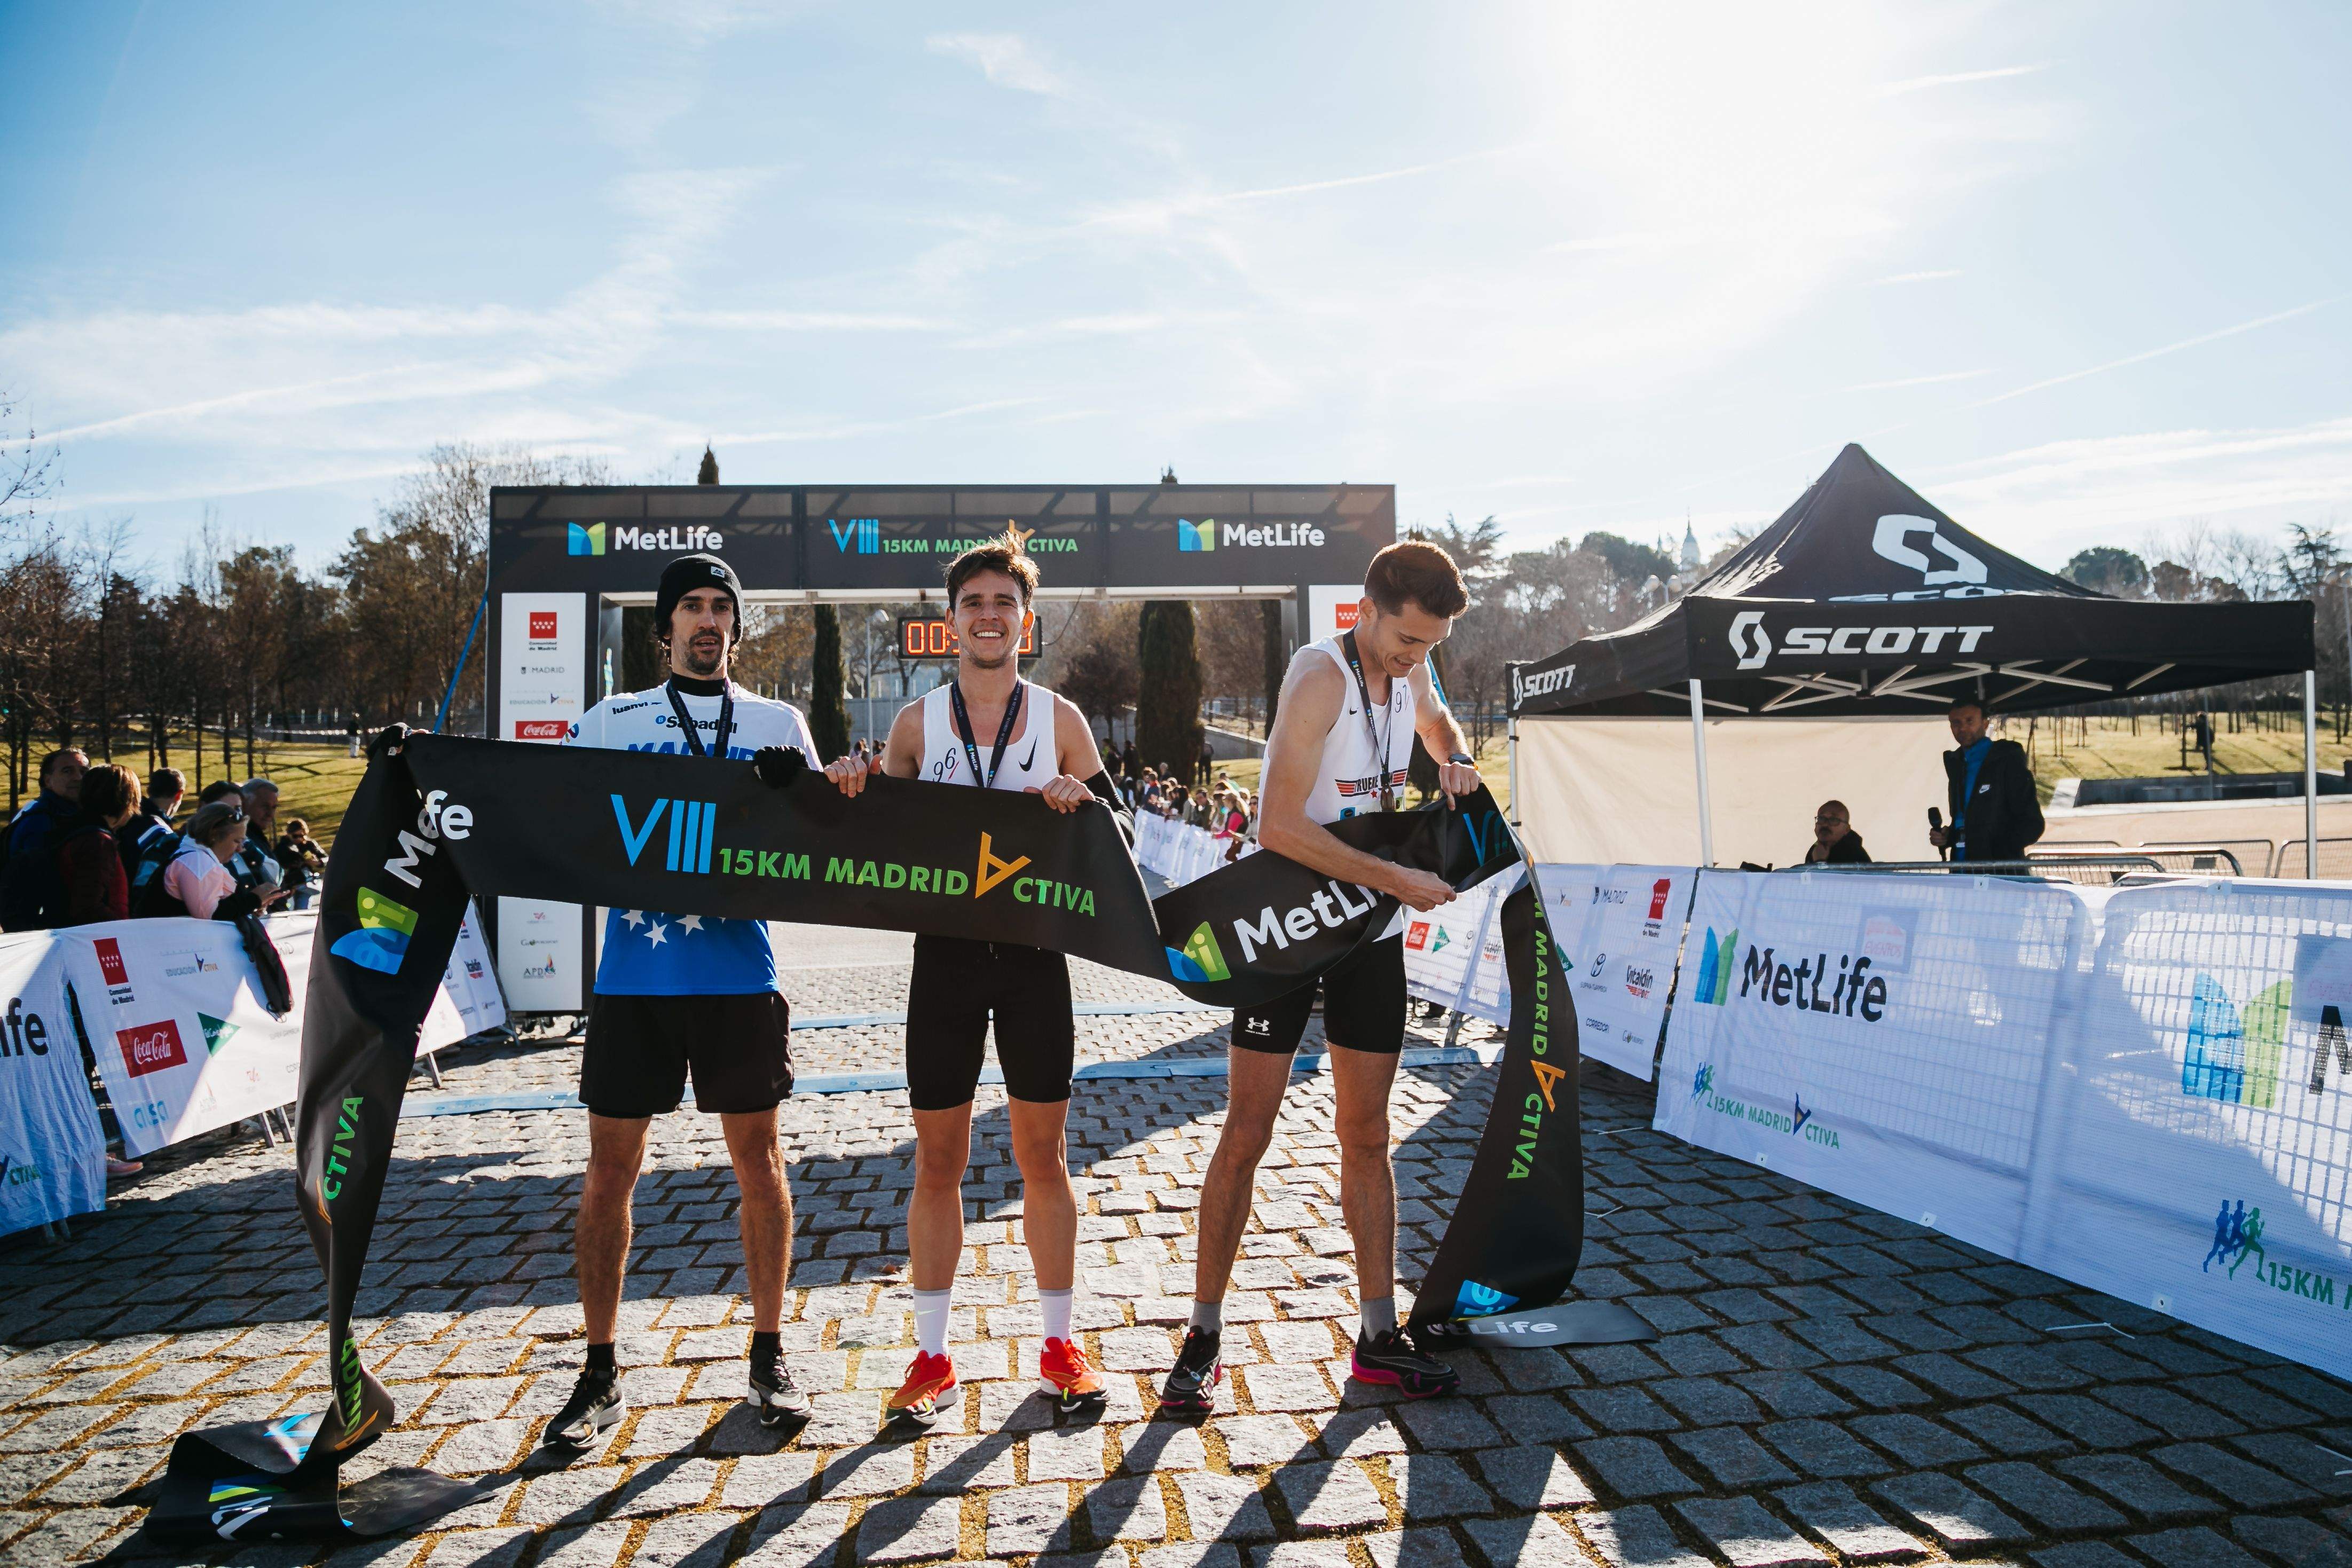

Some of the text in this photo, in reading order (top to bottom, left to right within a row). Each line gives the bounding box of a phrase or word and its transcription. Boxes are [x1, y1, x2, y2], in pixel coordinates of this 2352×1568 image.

[615, 525, 723, 550] MetLife
[828, 519, 879, 554] VIII
[883, 539, 930, 553] 15KM
[1223, 523, 1325, 548] MetLife
[1779, 626, 1994, 655] SCOTT
[1523, 665, 1576, 698] SCOTT
[612, 702, 648, 714] luanvi
[523, 724, 560, 736] Coca-Cola
[611, 794, 717, 874] VIII
[719, 848, 811, 880] 15KM
[825, 857, 969, 895] MADRID
[1603, 889, 1628, 904] MADRID
[1531, 931, 1548, 1055] MADRID
[1741, 944, 1887, 1022] MetLife
[134, 1032, 171, 1065] Coca-Cola
[1714, 1096, 1745, 1119] 15KM
[1749, 1106, 1791, 1133] MADRID
[2269, 1262, 2333, 1305] 15KM
